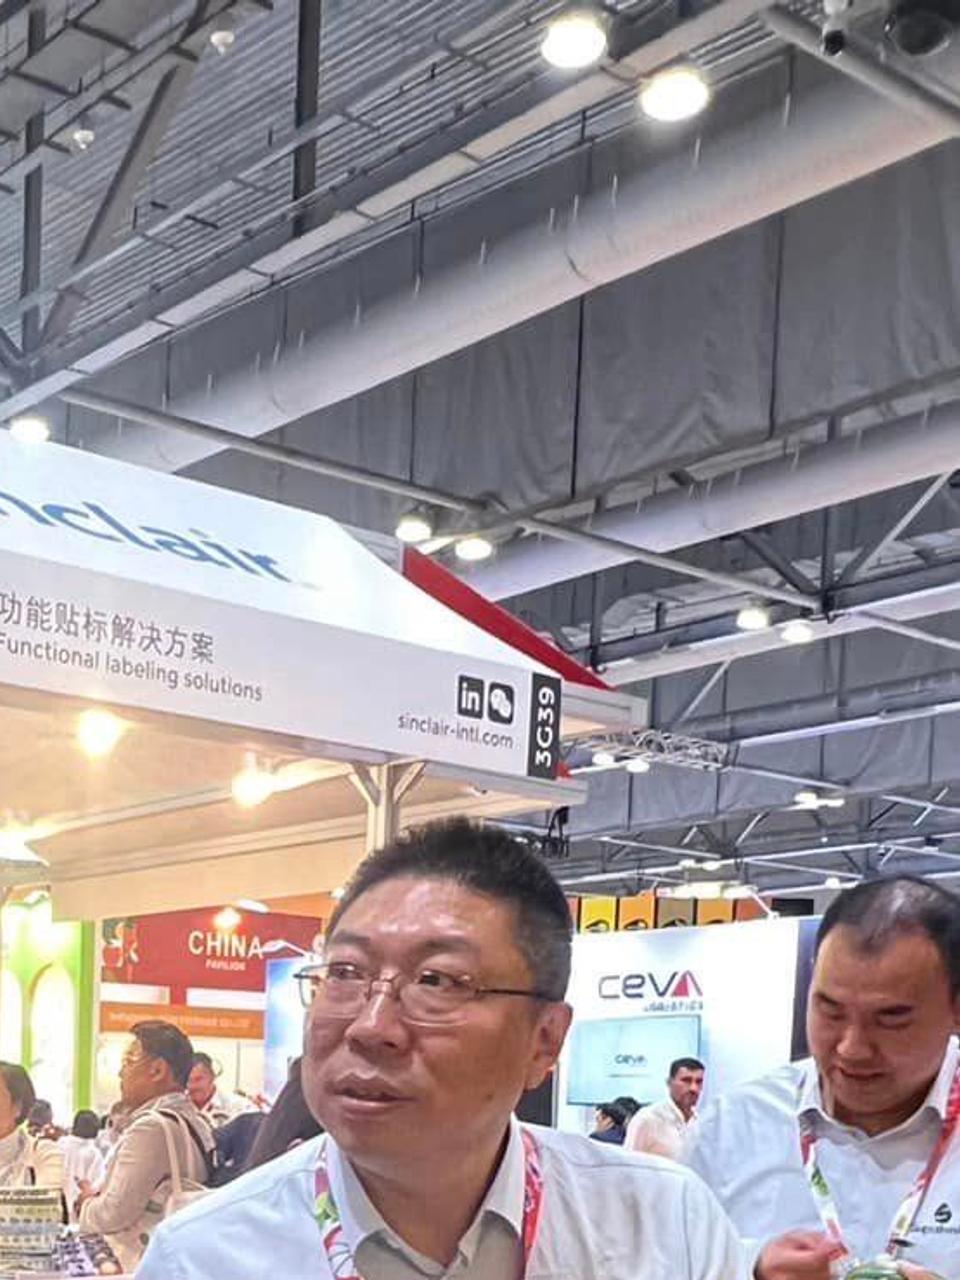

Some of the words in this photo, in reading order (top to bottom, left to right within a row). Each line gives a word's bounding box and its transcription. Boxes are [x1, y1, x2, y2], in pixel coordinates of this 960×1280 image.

[104, 651, 179, 690] labeling
[182, 666, 264, 702] solutions
[397, 711, 514, 749] sinclair-intl.com
[535, 686, 555, 767] 3G39
[188, 930, 264, 959] CHINA
